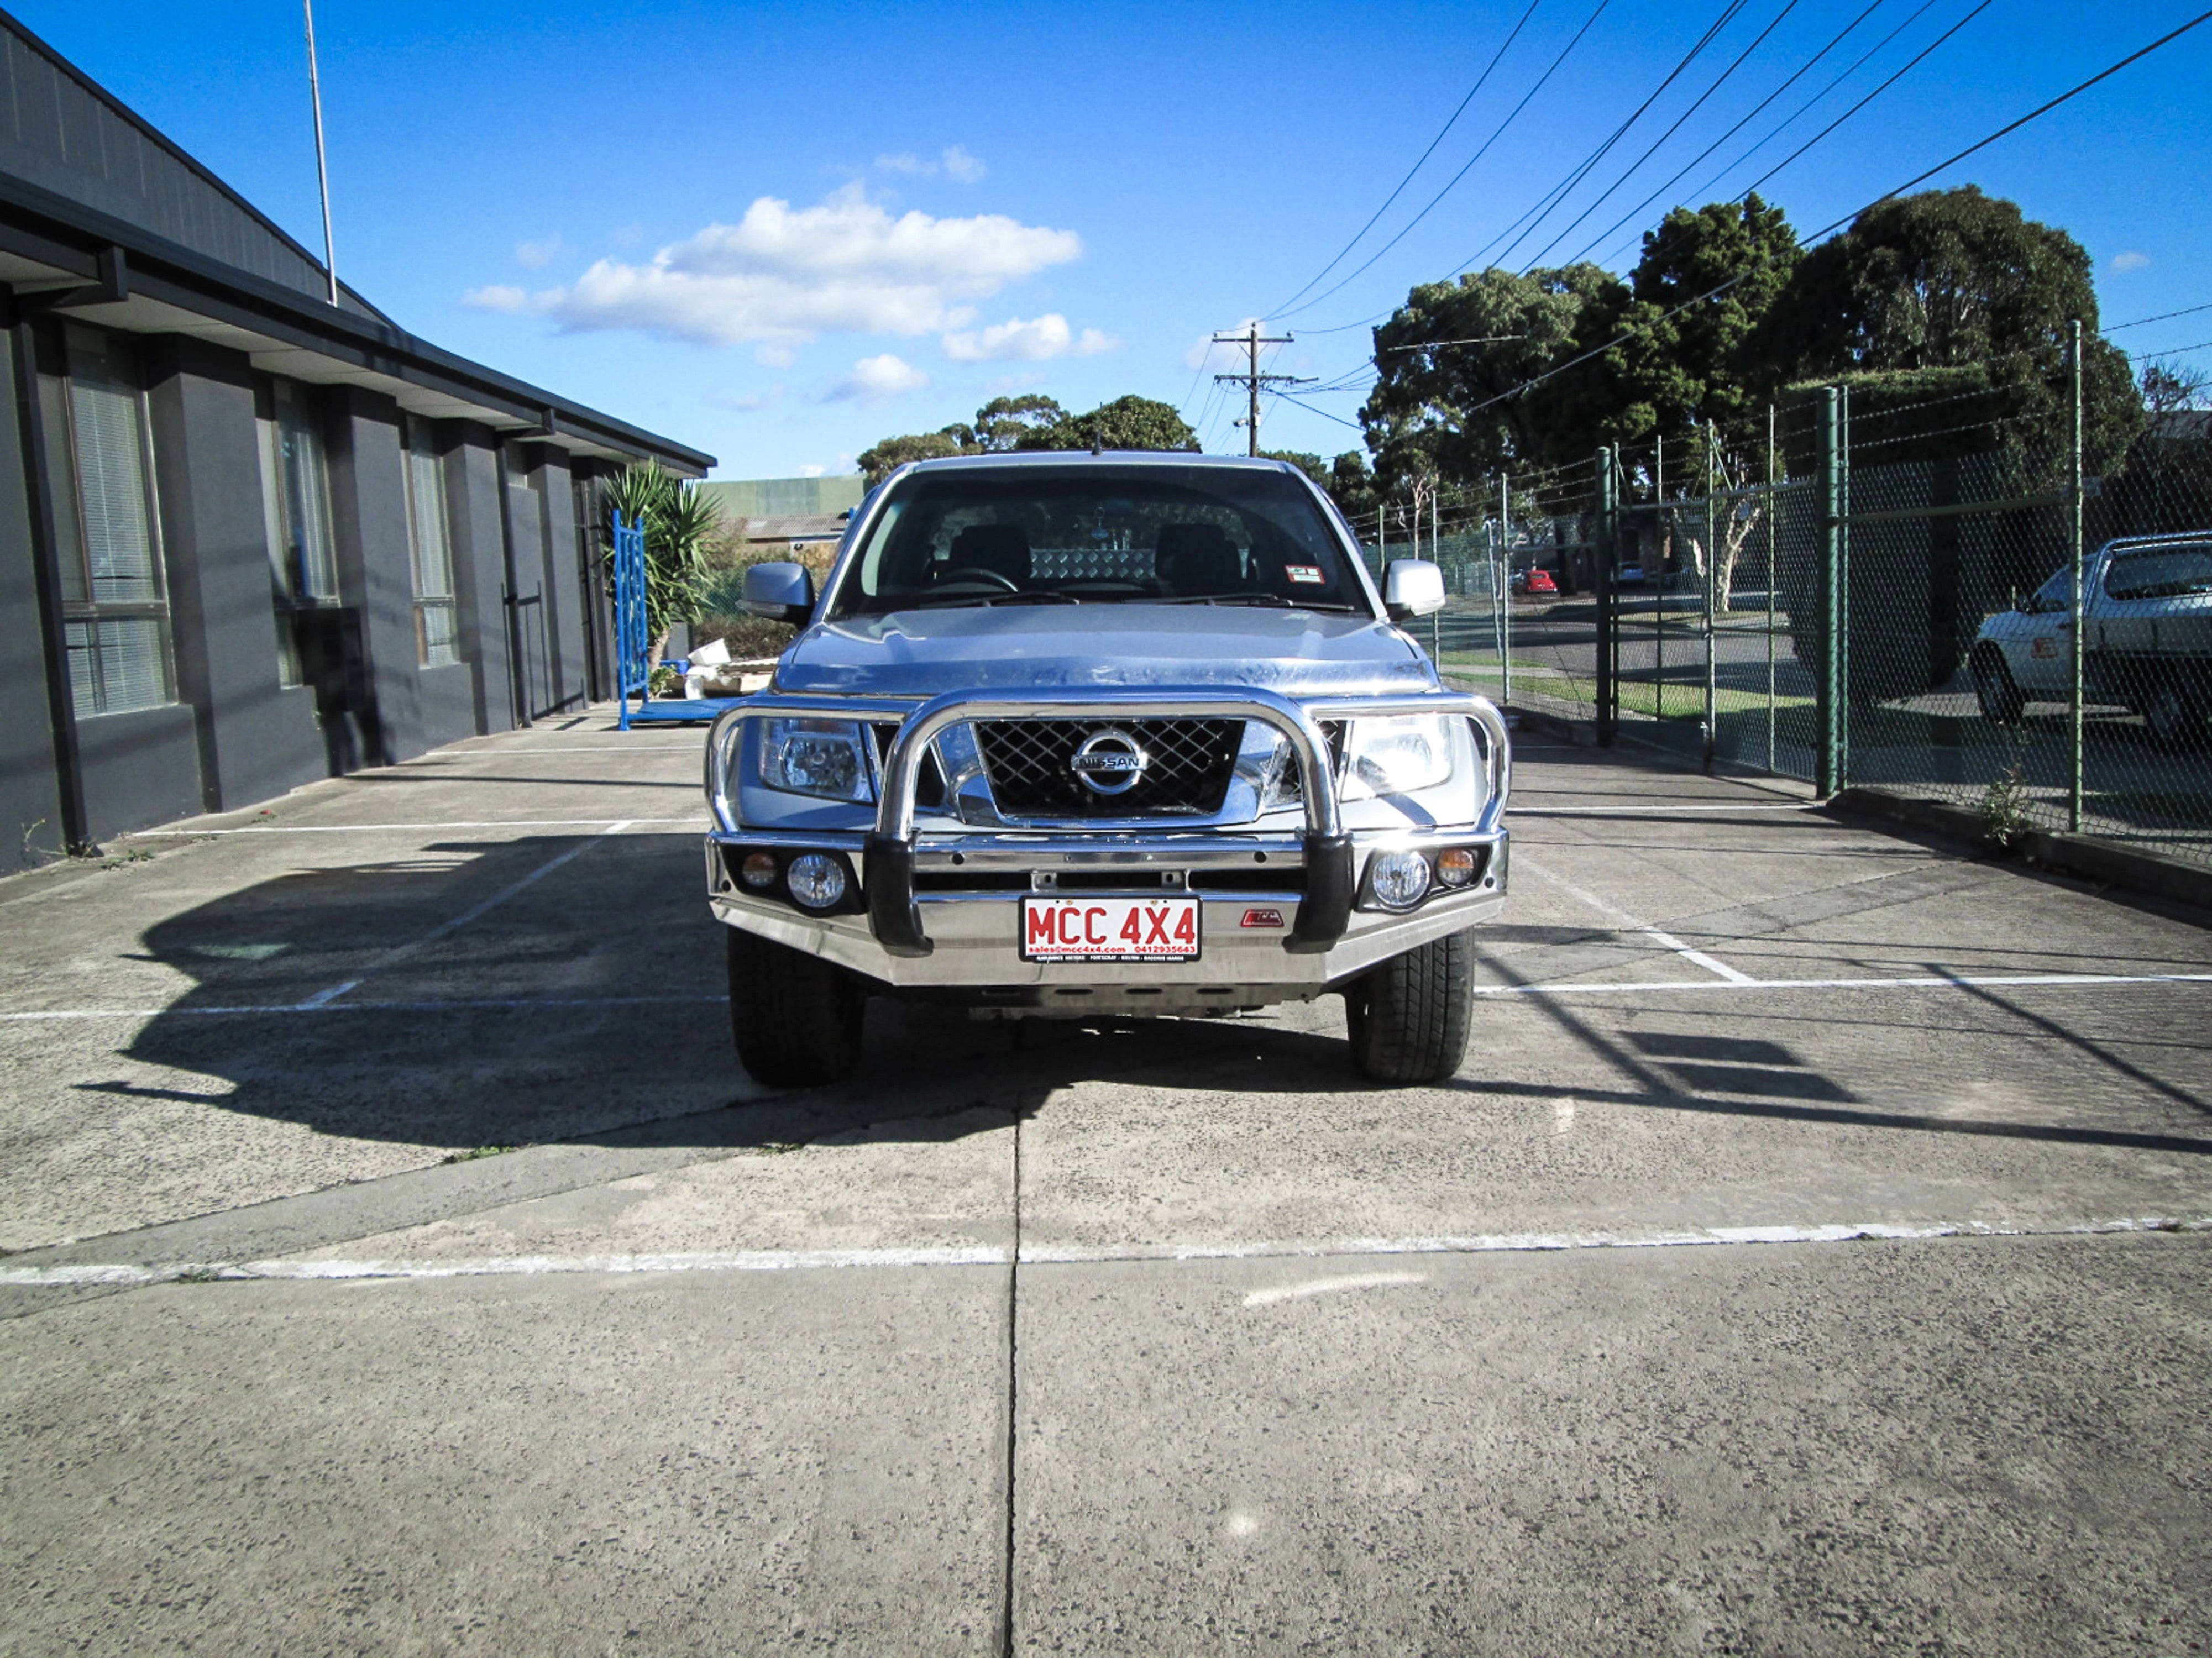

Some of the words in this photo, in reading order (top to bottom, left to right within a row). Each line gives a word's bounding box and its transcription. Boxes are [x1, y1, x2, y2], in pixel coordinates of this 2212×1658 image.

[1079, 757, 1139, 767] NISSAN
[1028, 907, 1107, 945] MCC
[1119, 907, 1196, 945] 4X4
